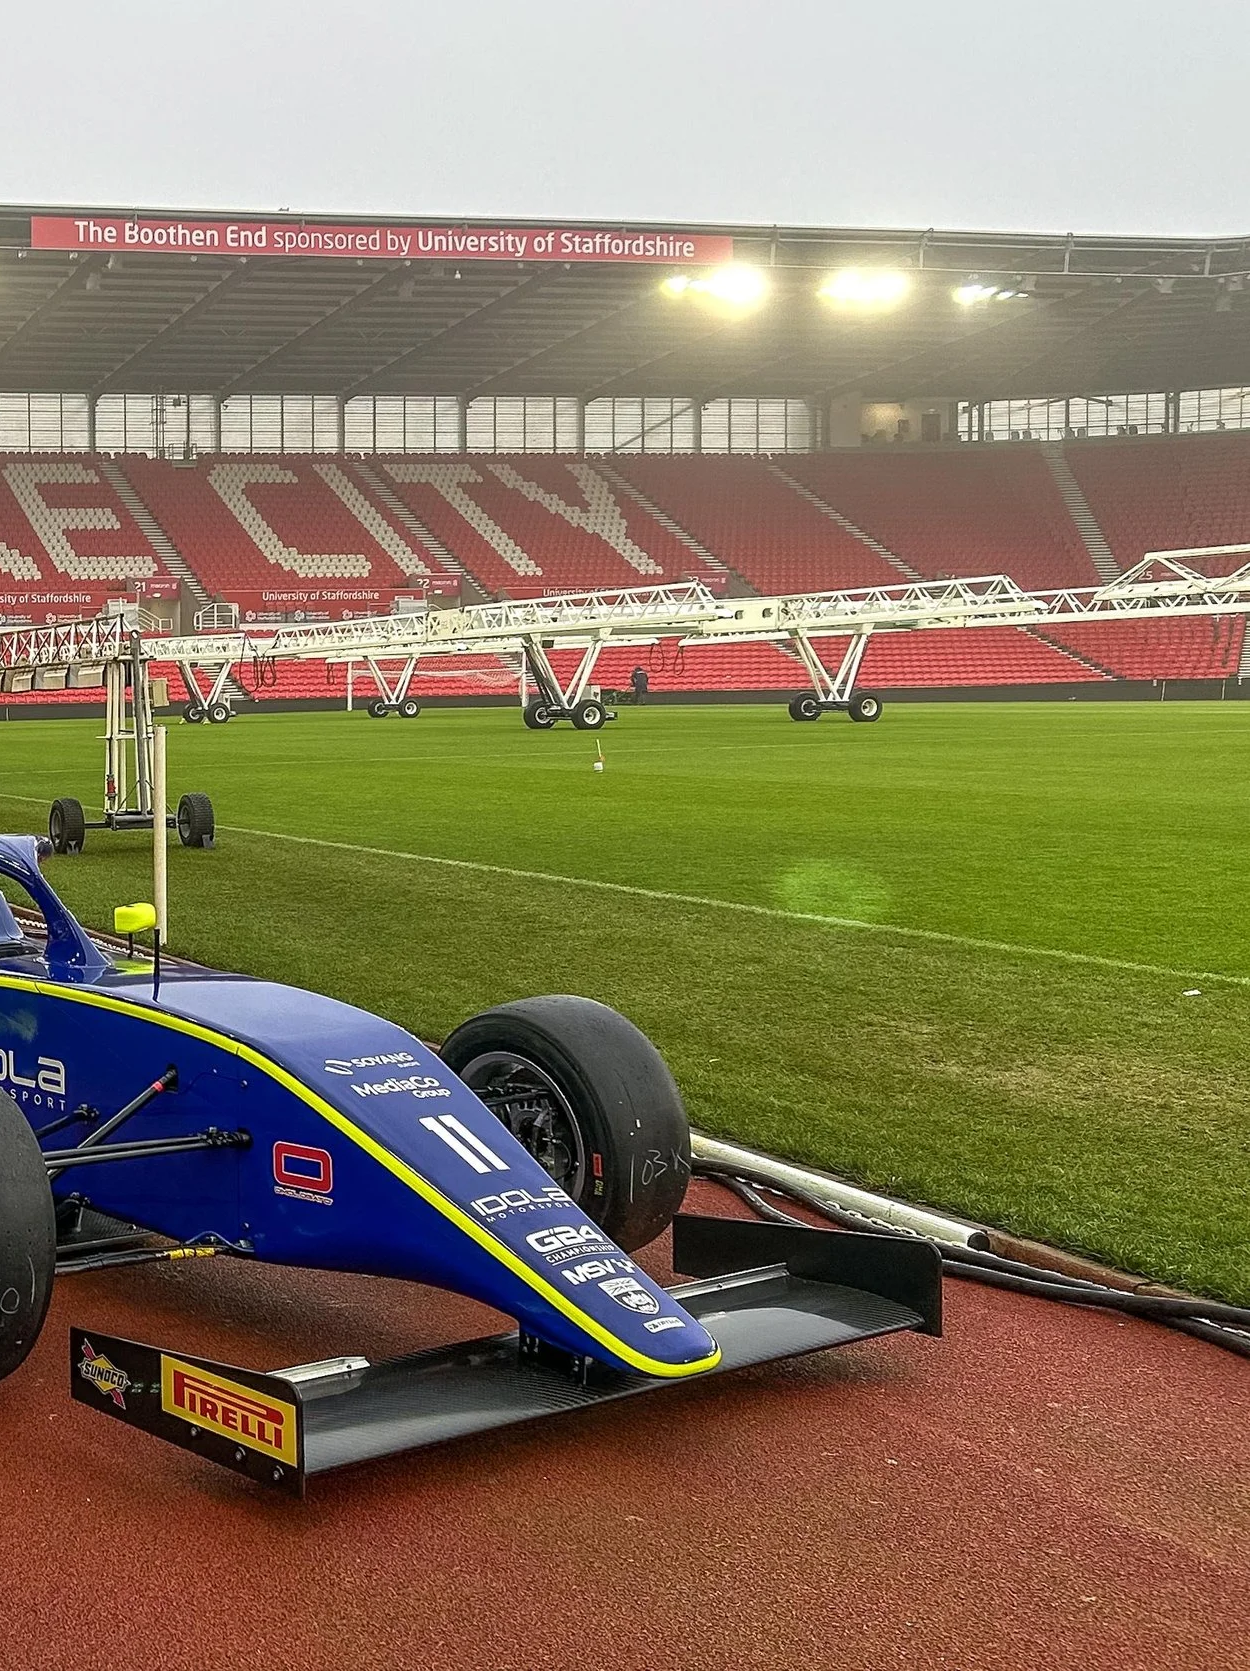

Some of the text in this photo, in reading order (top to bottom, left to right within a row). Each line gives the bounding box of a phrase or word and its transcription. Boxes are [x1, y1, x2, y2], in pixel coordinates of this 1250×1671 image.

[74, 221, 695, 258] The Boothen End sponsored by University of Staffordshire
[208, 463, 663, 578] CITY
[19, 593, 29, 603] of
[31, 593, 91, 603] Staffordshire
[134, 581, 146, 592] 21
[262, 590, 379, 602] University of Staffordshire
[351, 1052, 414, 1068] SOYANG
[350, 1076, 440, 1098] MediaCo
[412, 1088, 452, 1099] Group
[418, 1114, 511, 1174] 11
[525, 1225, 605, 1253] GB4
[545, 1244, 616, 1263] CHAMPIONSHIP
[561, 1259, 617, 1286] MSV
[82, 1362, 126, 1389] SUNOCO
[172, 1369, 285, 1451] PIRELLI
